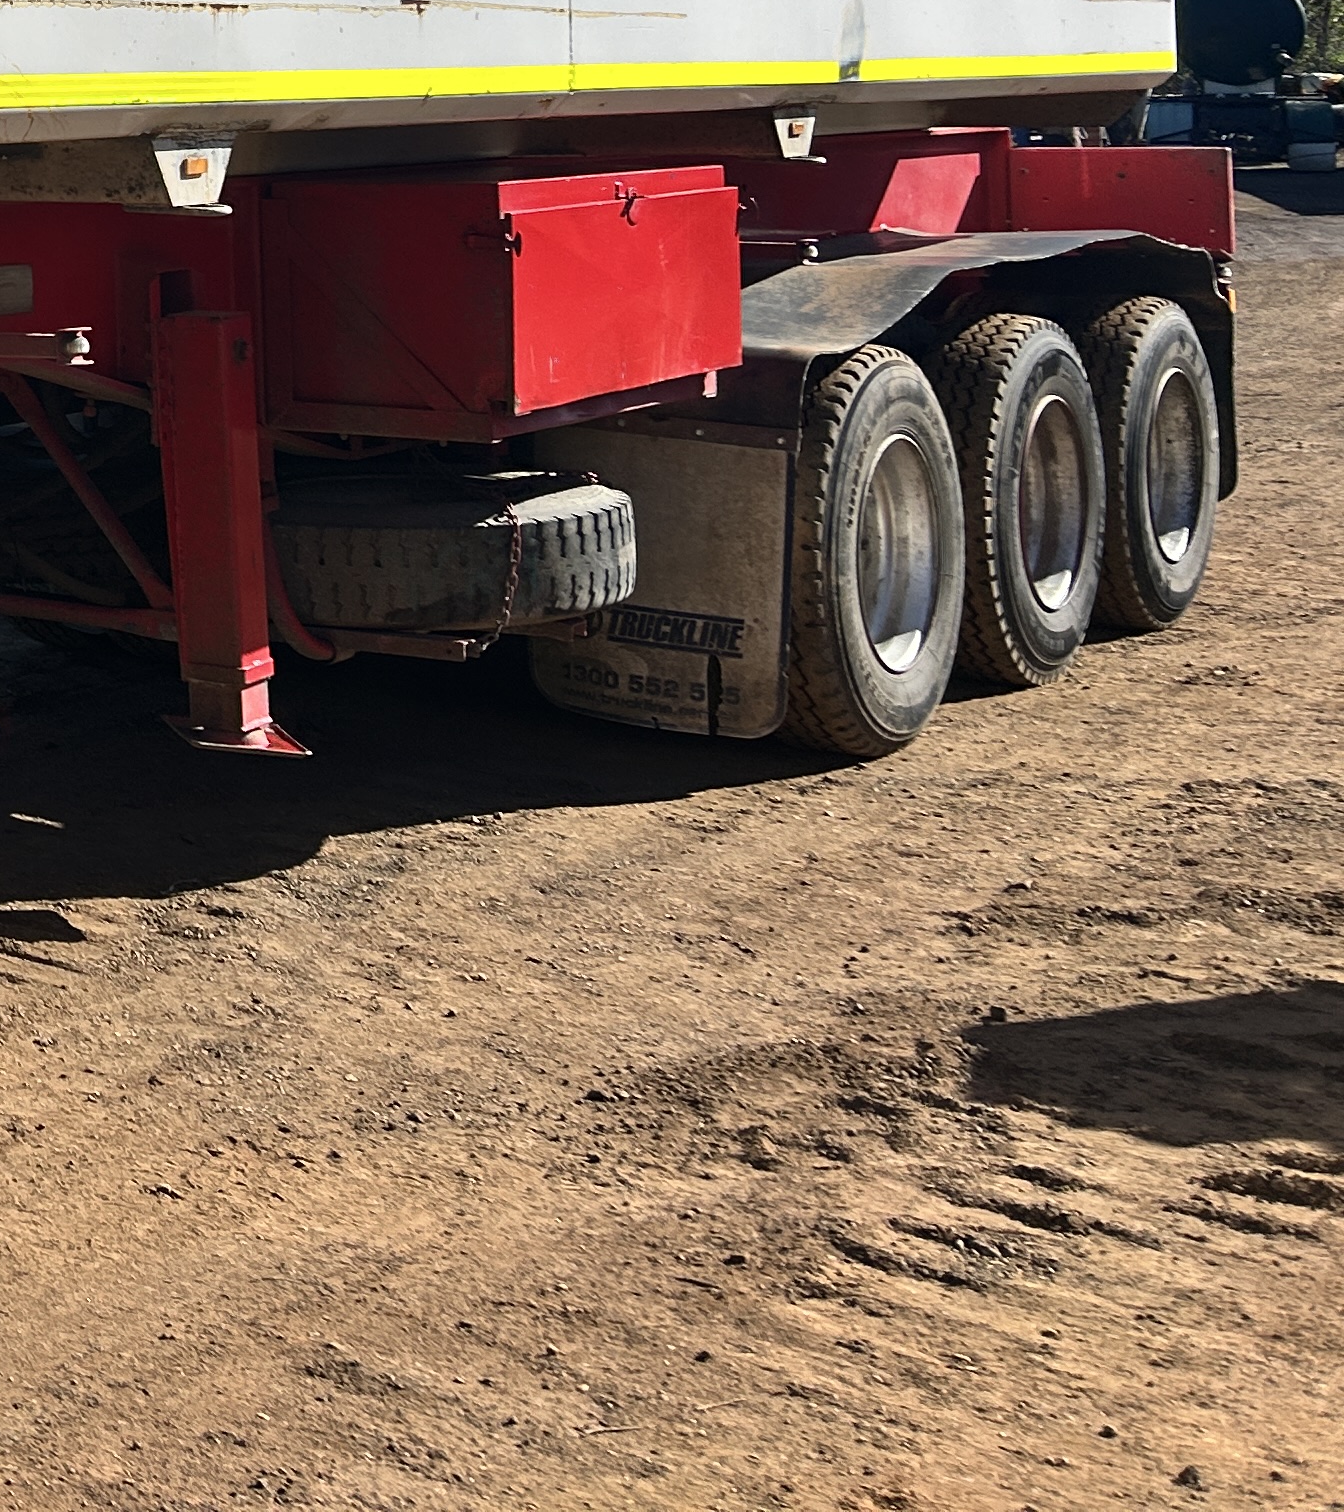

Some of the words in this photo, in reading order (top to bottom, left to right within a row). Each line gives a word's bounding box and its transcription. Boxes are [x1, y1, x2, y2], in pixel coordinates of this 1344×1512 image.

[608, 607, 745, 651] TRUCKLINE
[561, 662, 620, 689] 1300
[627, 673, 679, 699] 552
[689, 681, 741, 705] 55
